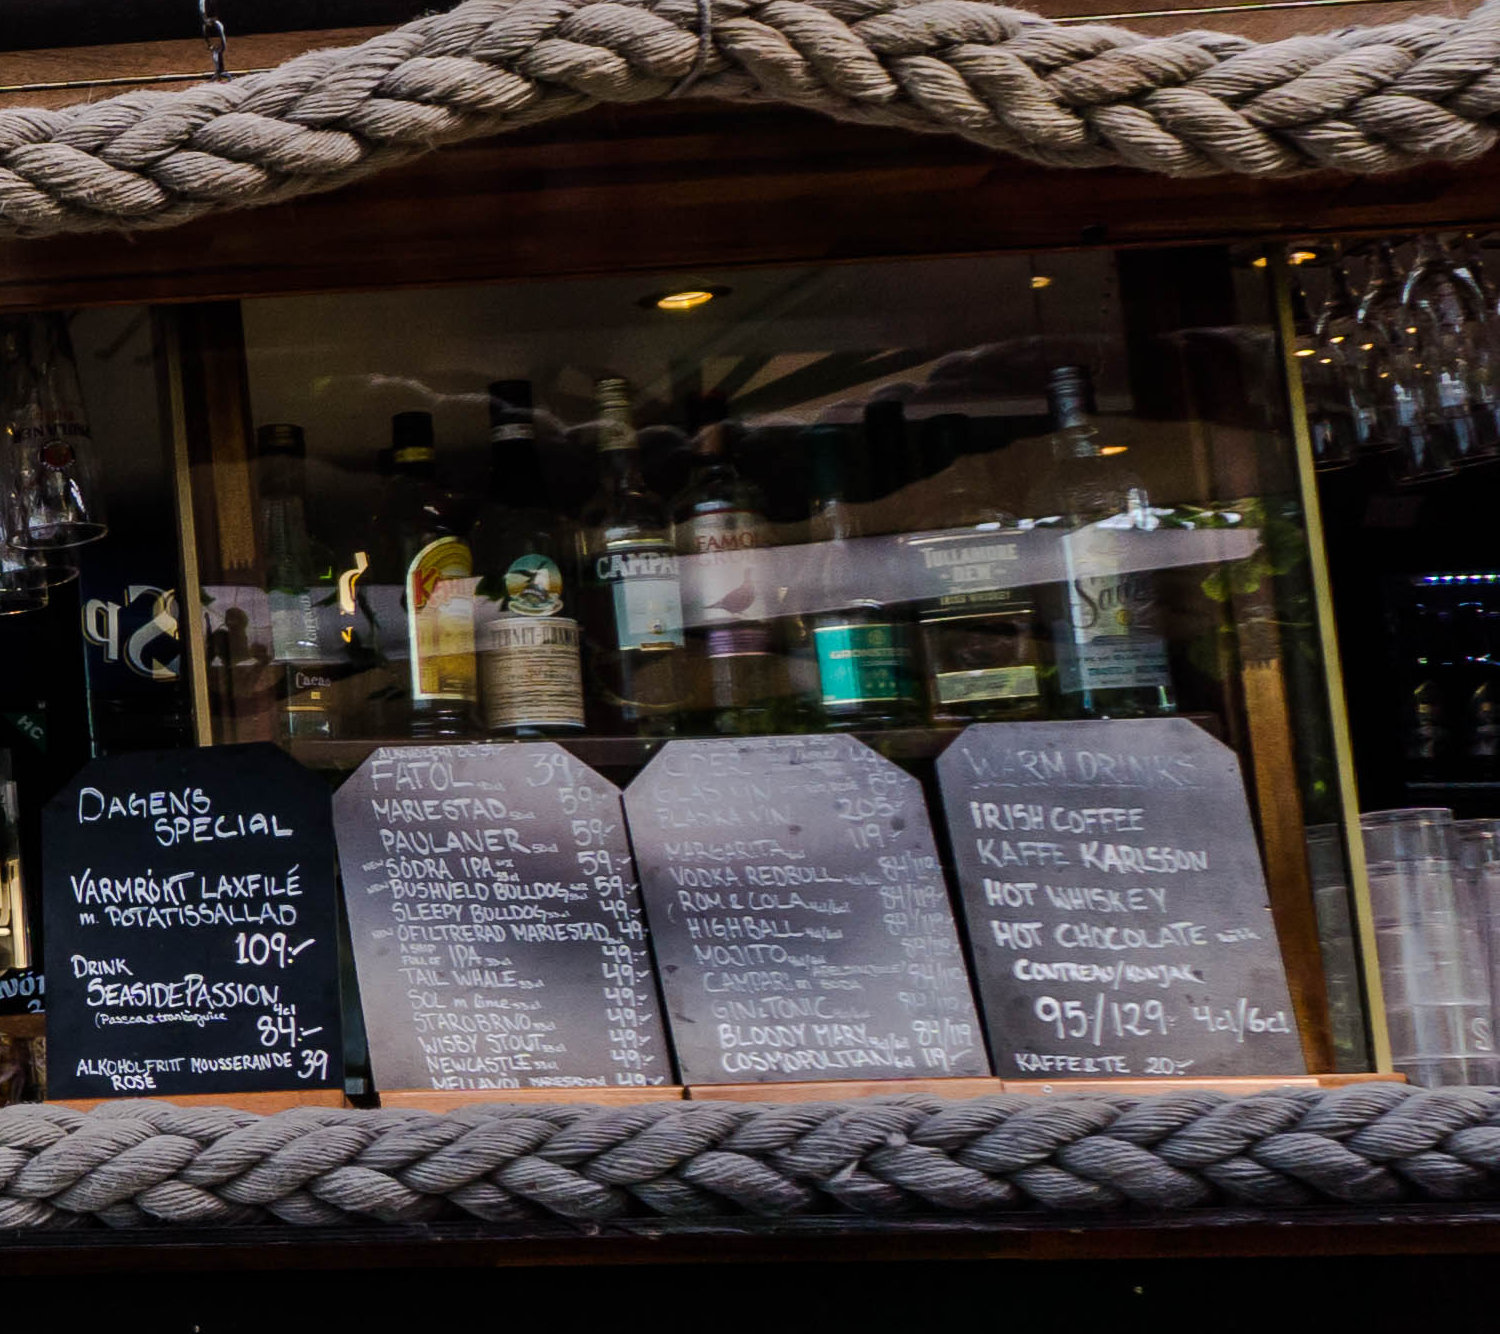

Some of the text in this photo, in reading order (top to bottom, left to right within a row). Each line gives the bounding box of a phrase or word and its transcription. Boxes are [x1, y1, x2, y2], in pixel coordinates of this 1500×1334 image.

[77, 786, 213, 824] DAGENS
[370, 798, 507, 824] MARIESTAD
[153, 812, 294, 847] SPECIAL
[969, 801, 1146, 834] IRISH COFFEE
[378, 828, 533, 855] PAULANER
[663, 839, 784, 861] MARGARITA
[975, 837, 1071, 868] KAFFE
[384, 856, 454, 880] SÖDRA
[463, 856, 495, 879] IPA
[669, 866, 739, 889] VODKA
[200, 863, 303, 901] LAXFILÉ
[678, 890, 722, 914] ROM
[747, 890, 805, 912] COLA
[981, 877, 1168, 913] HOT WHISKEY
[103, 901, 298, 929] POTATISSALLAD
[391, 901, 463, 923] SLEEPY
[397, 923, 506, 943] OFILTRERAD
[511, 923, 610, 944] MARIESTAD
[686, 916, 804, 939] HIGHBALL
[989, 919, 1209, 950] HOT CHOCOLATE
[70, 954, 134, 979] DRINK
[449, 944, 483, 967] IPA
[693, 943, 789, 966] MOJITO
[397, 967, 450, 987] TAIL
[452, 968, 518, 988] WHALE
[701, 970, 794, 992] CAMPARI
[407, 989, 447, 1009] SOL
[417, 1035, 478, 1054] WISBY
[485, 1033, 546, 1054] STOUT
[717, 1023, 807, 1049] BLOODY
[811, 1023, 867, 1047] MARY
[76, 1048, 330, 1081] ALKOHOLFRITT MOUSSERANDE 39
[425, 1054, 533, 1074] NEWCASTLE
[721, 1048, 895, 1073] COSMOPOLITAN
